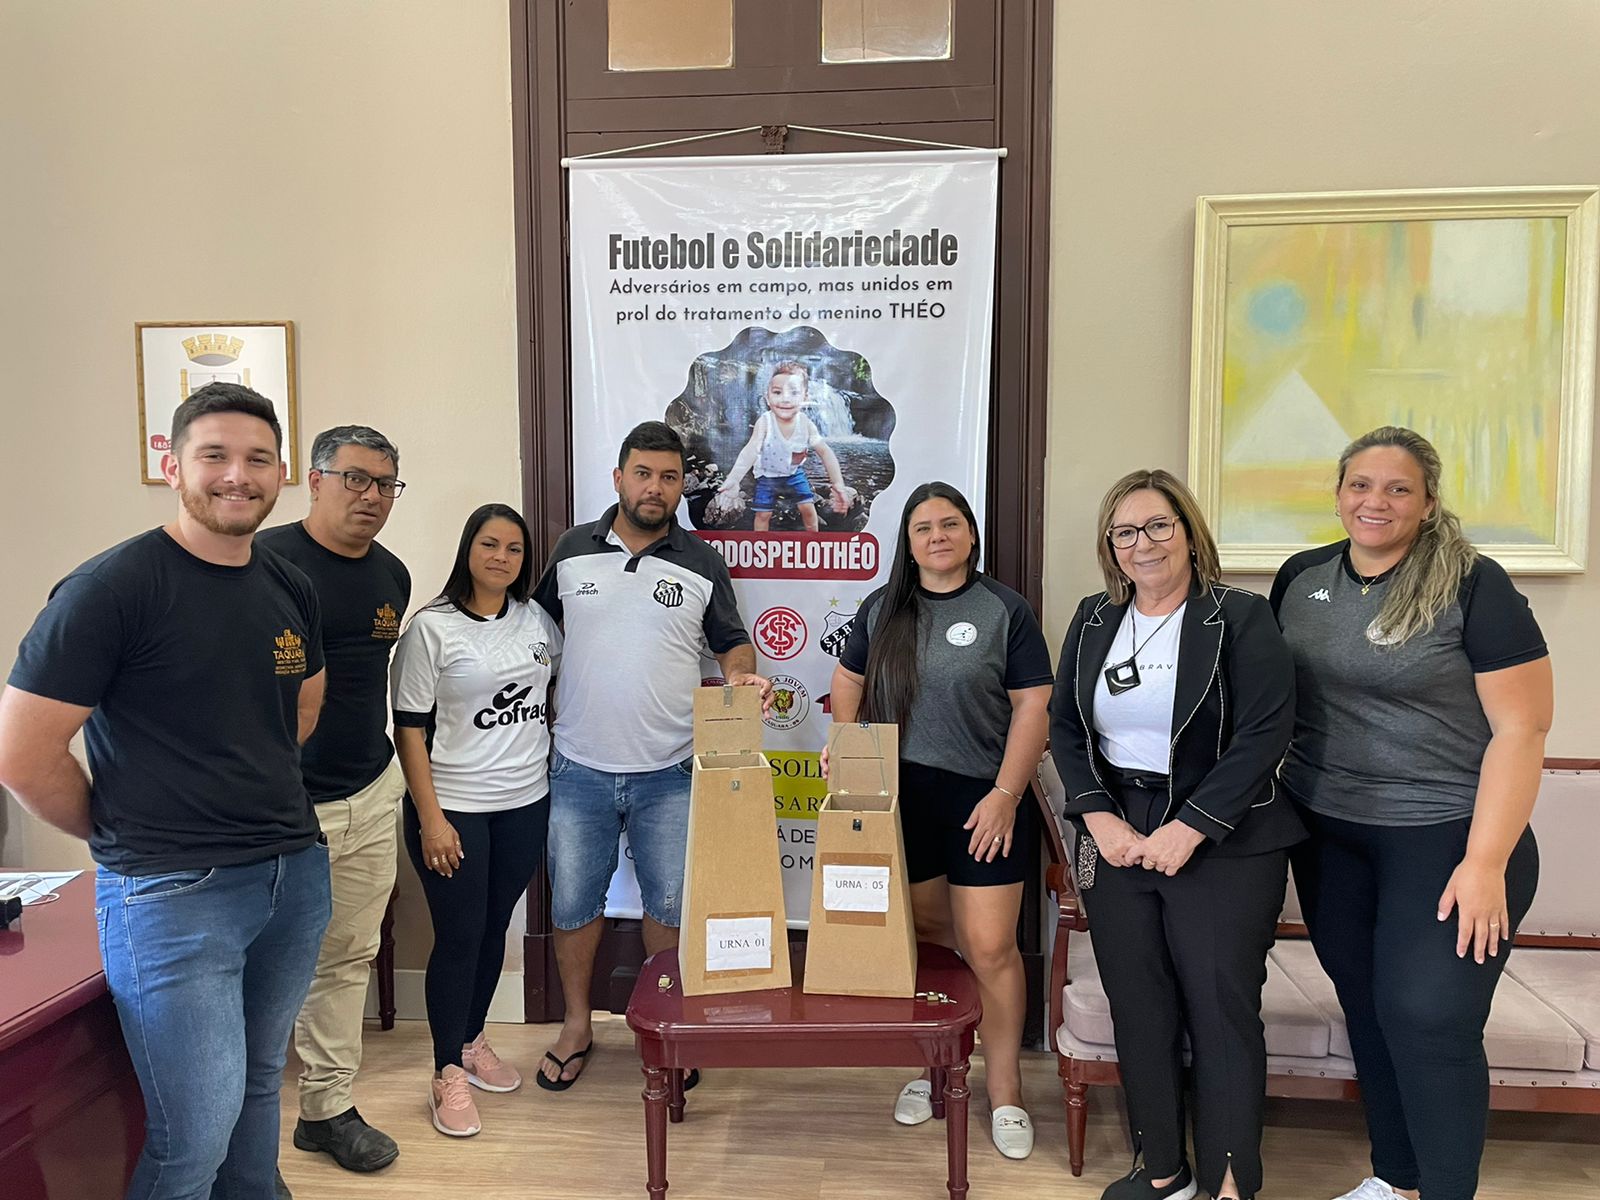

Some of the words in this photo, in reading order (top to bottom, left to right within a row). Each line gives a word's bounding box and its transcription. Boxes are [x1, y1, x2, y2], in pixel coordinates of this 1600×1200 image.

[609, 232, 715, 270] Futebol
[722, 238, 740, 269] e
[747, 228, 958, 269] Solidariedade
[609, 277, 710, 294] Adversários
[717, 282, 742, 293] em
[749, 281, 812, 296] campo,
[819, 280, 854, 292] mas
[862, 274, 919, 291] unidos
[926, 279, 953, 291] em
[616, 304, 649, 325] prol
[655, 304, 677, 321] do
[683, 306, 782, 321] tratamento
[789, 303, 811, 320] do
[818, 305, 882, 319] menino
[889, 299, 945, 319] THÉO
[703, 535, 876, 570] DOSPELOTHÉO
[1139, 663, 1173, 671] BRAV
[835, 879, 863, 889] URNA
[872, 880, 884, 890] 05
[719, 939, 750, 950] URNA
[754, 938, 766, 948] 01
